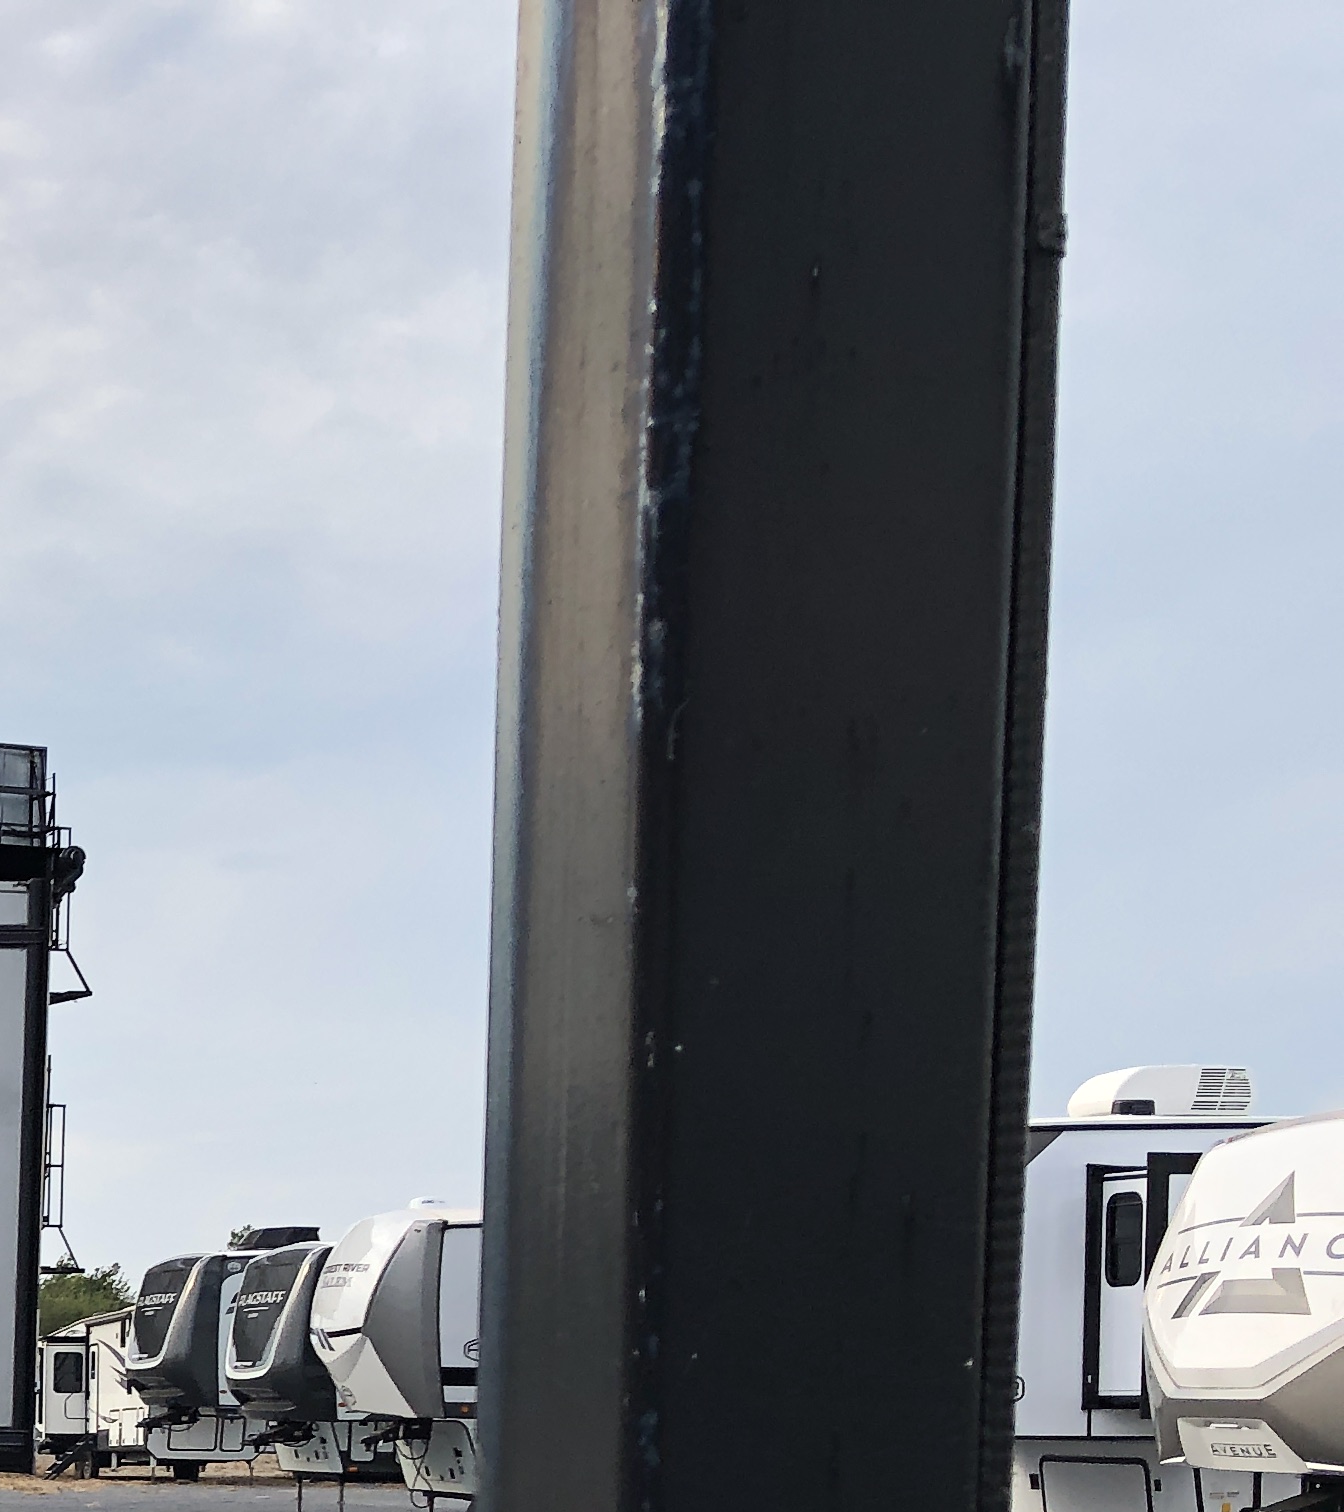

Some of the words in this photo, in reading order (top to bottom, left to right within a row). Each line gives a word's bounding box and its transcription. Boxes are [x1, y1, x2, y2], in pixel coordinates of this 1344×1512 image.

[1160, 1233, 1344, 1275] ALLIANC
[238, 1290, 286, 1307] FLAGSTAFF
[1211, 1443, 1277, 1458] AVENUE
